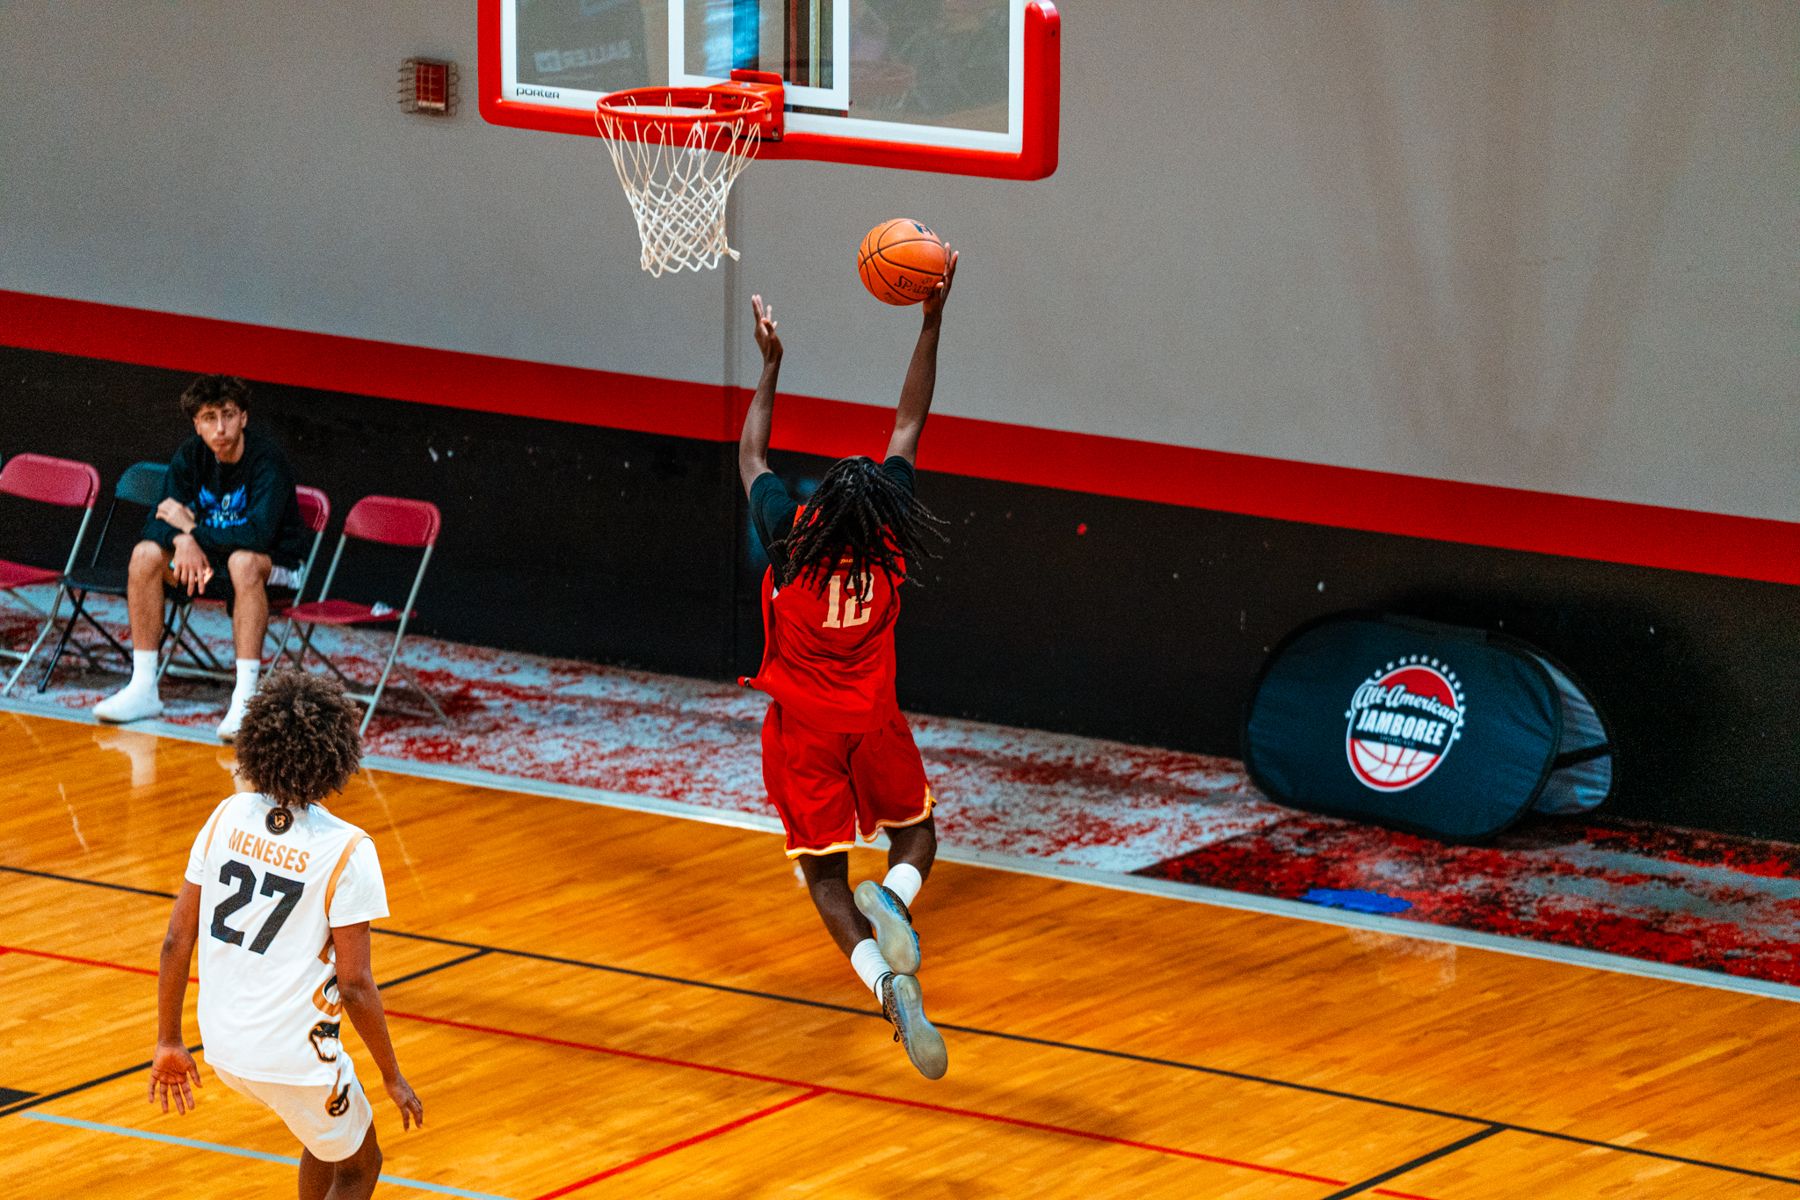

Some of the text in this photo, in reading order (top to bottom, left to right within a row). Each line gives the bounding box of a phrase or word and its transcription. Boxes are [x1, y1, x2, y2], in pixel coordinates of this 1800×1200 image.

[894, 275, 930, 294] SPALD
[822, 572, 875, 628] 12
[1355, 684, 1458, 723] All-American
[1356, 708, 1447, 746] JAMBOREE
[228, 828, 310, 873] MENESES
[211, 859, 305, 955] 27
